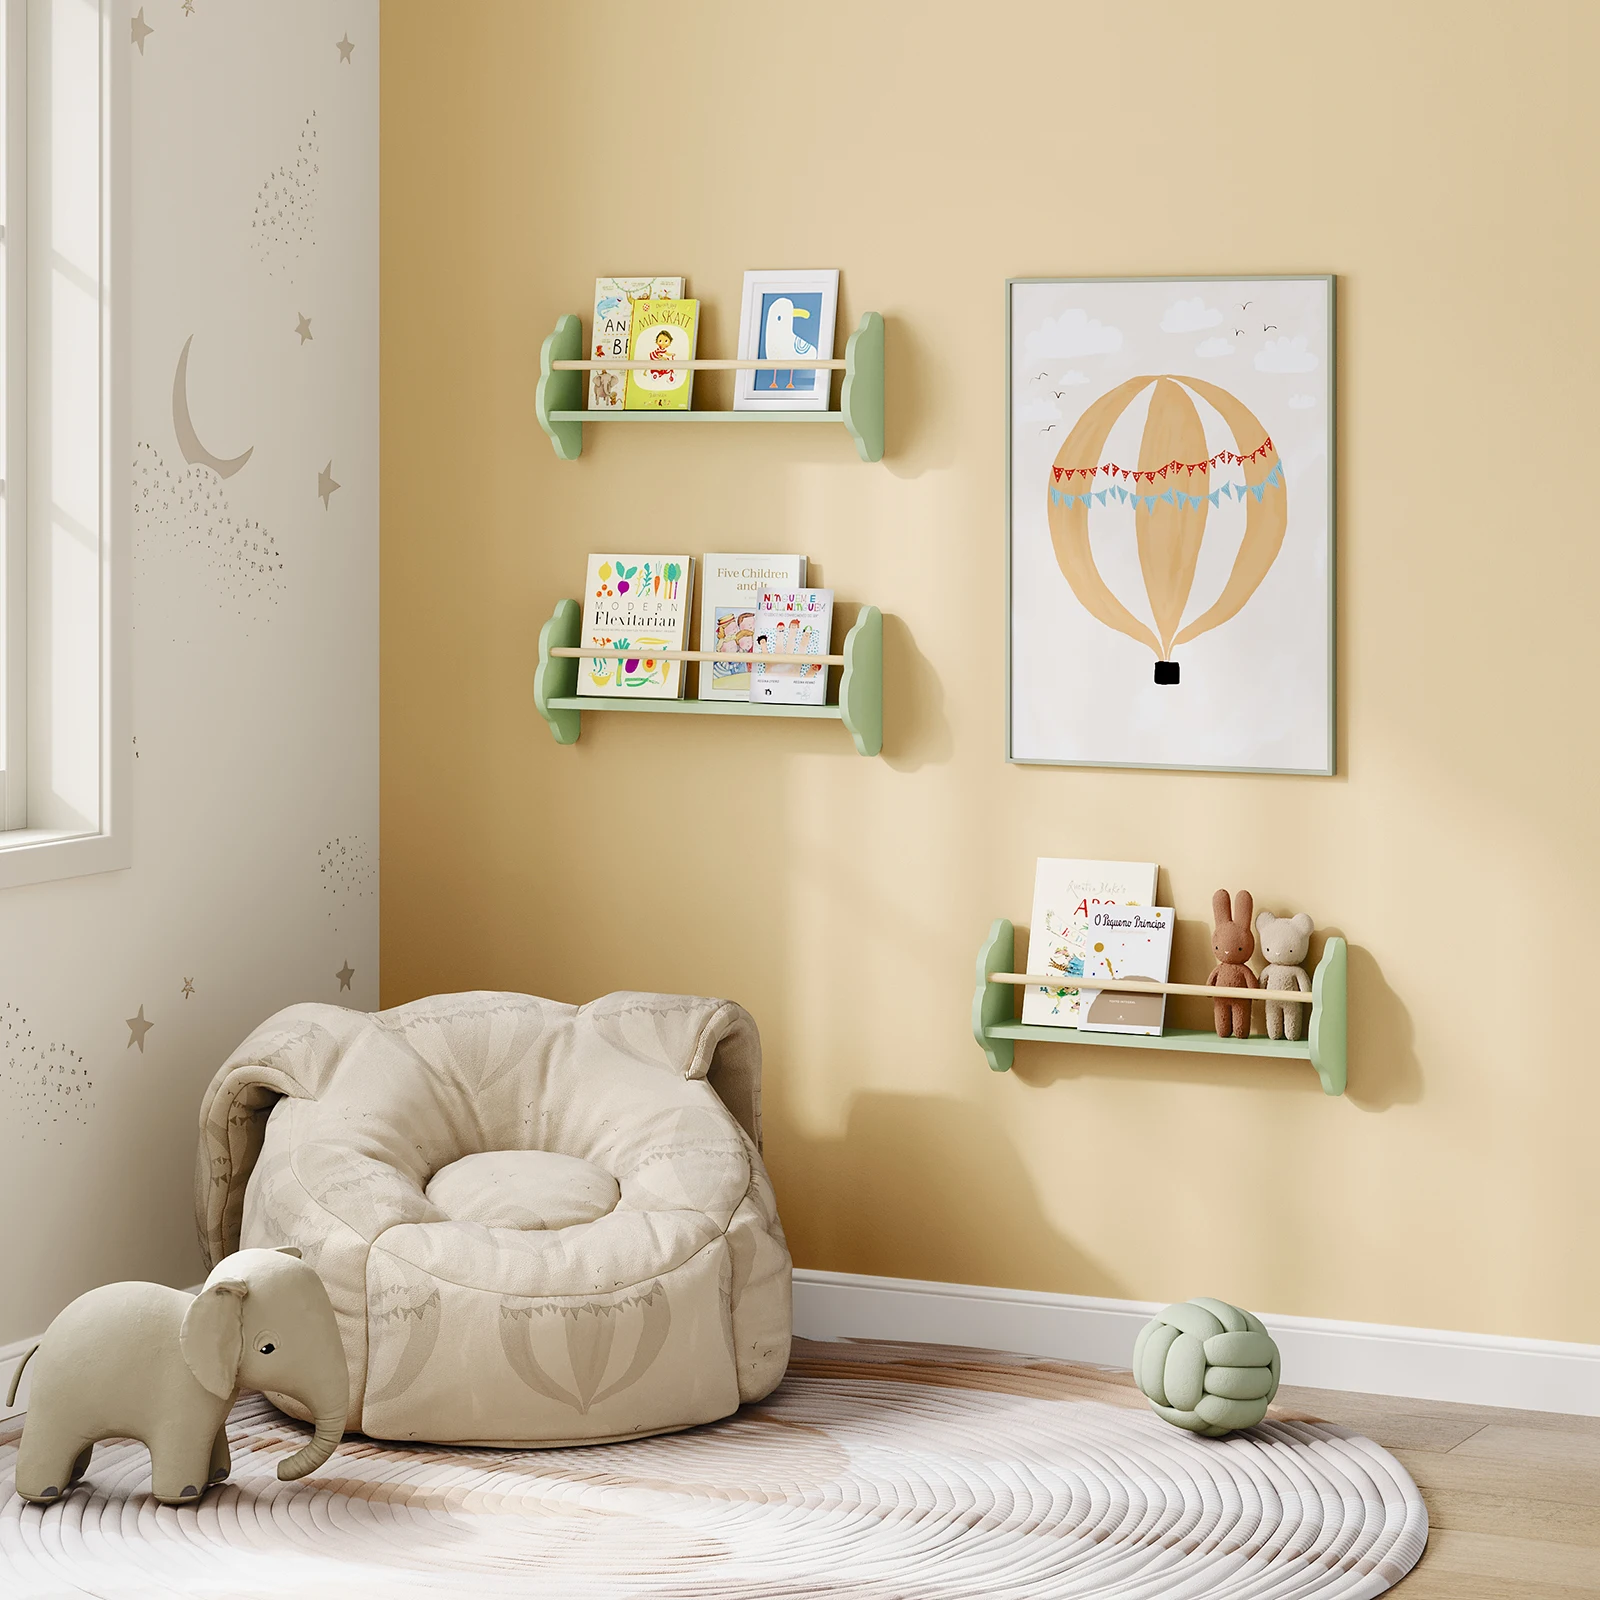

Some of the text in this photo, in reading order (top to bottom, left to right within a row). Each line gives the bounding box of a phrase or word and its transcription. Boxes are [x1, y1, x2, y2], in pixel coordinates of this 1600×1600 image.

[638, 309, 692, 331] MIN SKATT
[717, 567, 789, 579] Five Children
[736, 581, 757, 591] and
[594, 601, 679, 612] MODERN
[594, 611, 677, 627] Flexitarian
[1094, 913, 1102, 926] O
[1102, 913, 1132, 929] Pequeno
